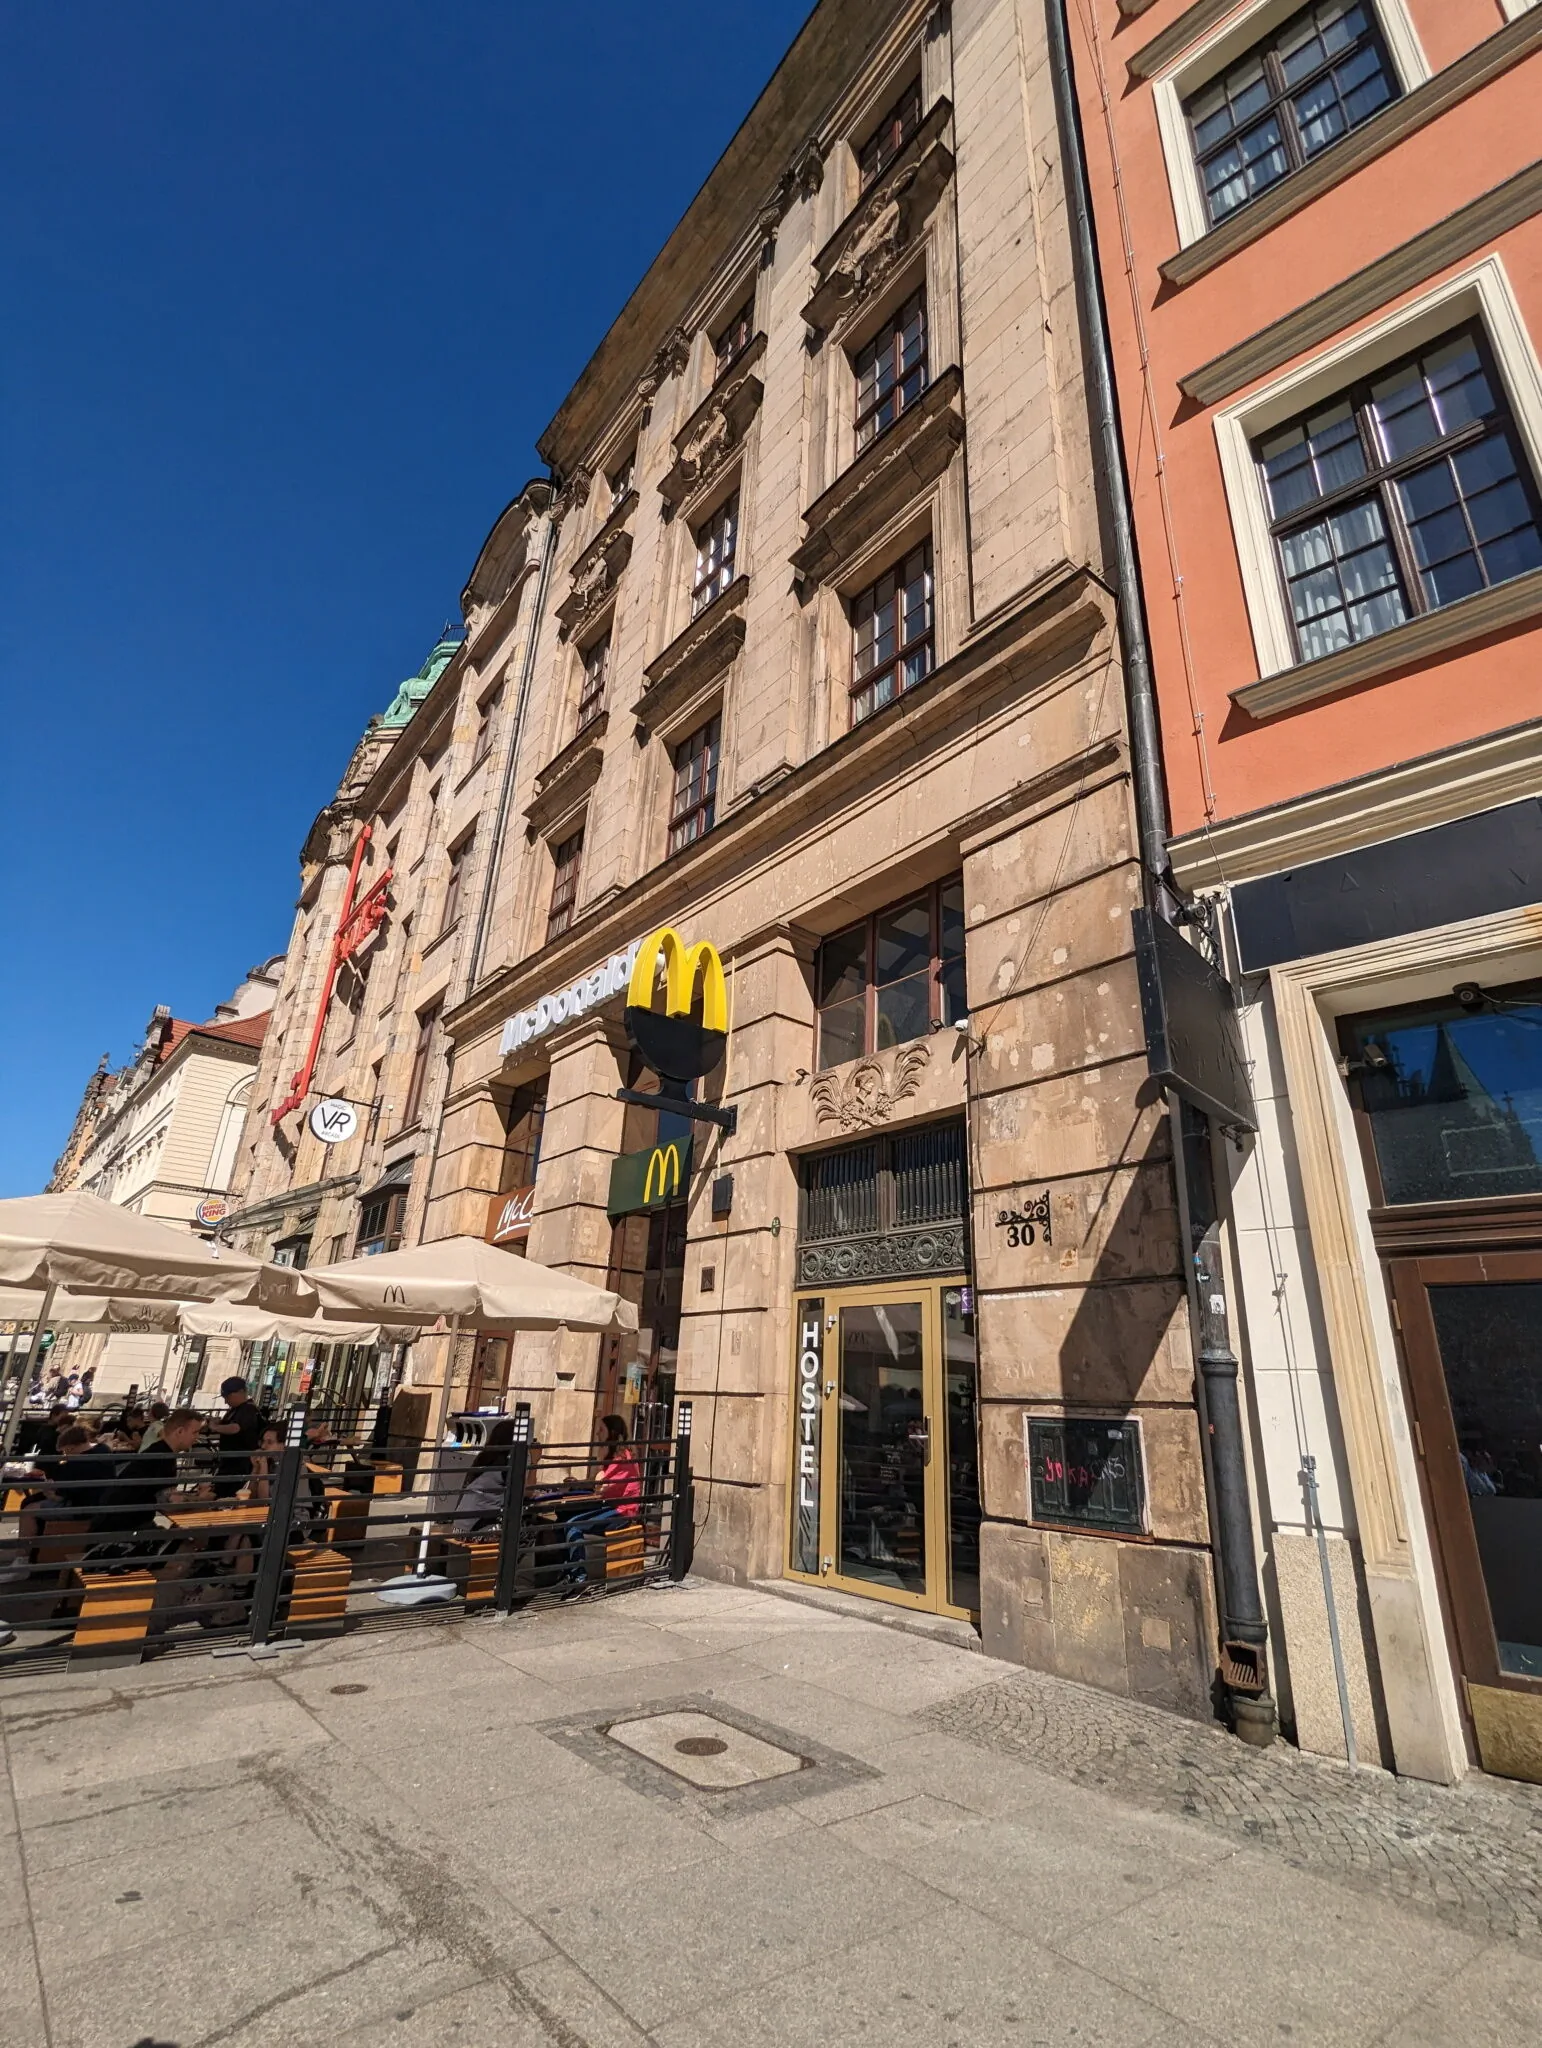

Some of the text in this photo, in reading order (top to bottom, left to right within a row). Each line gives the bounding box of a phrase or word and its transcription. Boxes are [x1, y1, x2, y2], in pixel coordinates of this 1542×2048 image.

[321, 1106, 351, 1133] VR
[201, 1209, 227, 1219] KING
[202, 1203, 226, 1212] BURGER
[495, 1188, 536, 1238] McC
[1006, 1224, 1036, 1248] 30
[799, 1320, 820, 1508] HOSTEL
